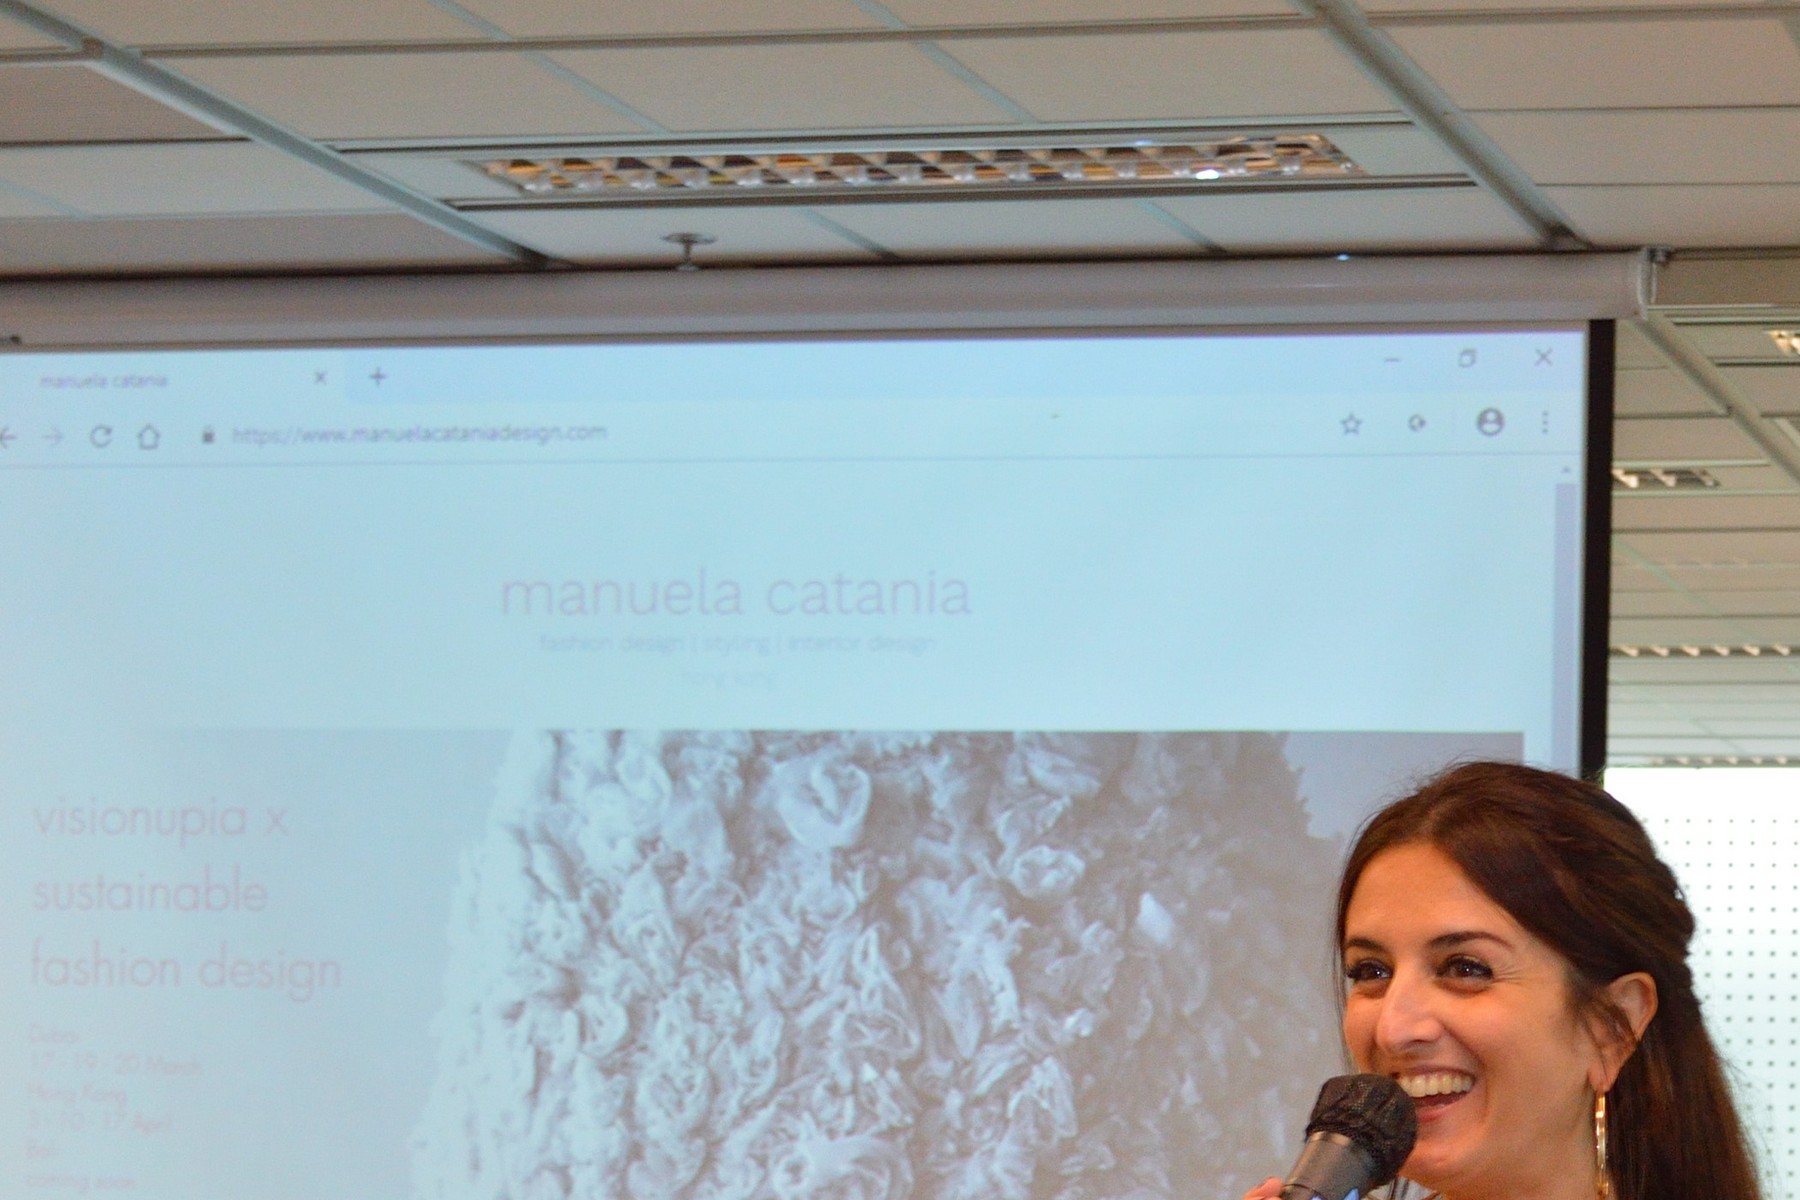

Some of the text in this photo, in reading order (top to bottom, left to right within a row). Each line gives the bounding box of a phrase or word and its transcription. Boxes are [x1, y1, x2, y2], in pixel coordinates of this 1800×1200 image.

[40, 371, 169, 389] manuela catania
[232, 422, 607, 447] https://www.manuelacataniadesign.com
[502, 567, 972, 616] manuela catania
[538, 633, 612, 652] fashion
[620, 634, 683, 657] design
[704, 634, 770, 658] styling
[787, 634, 860, 653] interior
[867, 635, 936, 657] design
[32, 796, 290, 848] visionupia x
[32, 863, 269, 911] sustainable
[30, 937, 343, 1003] fashion design
